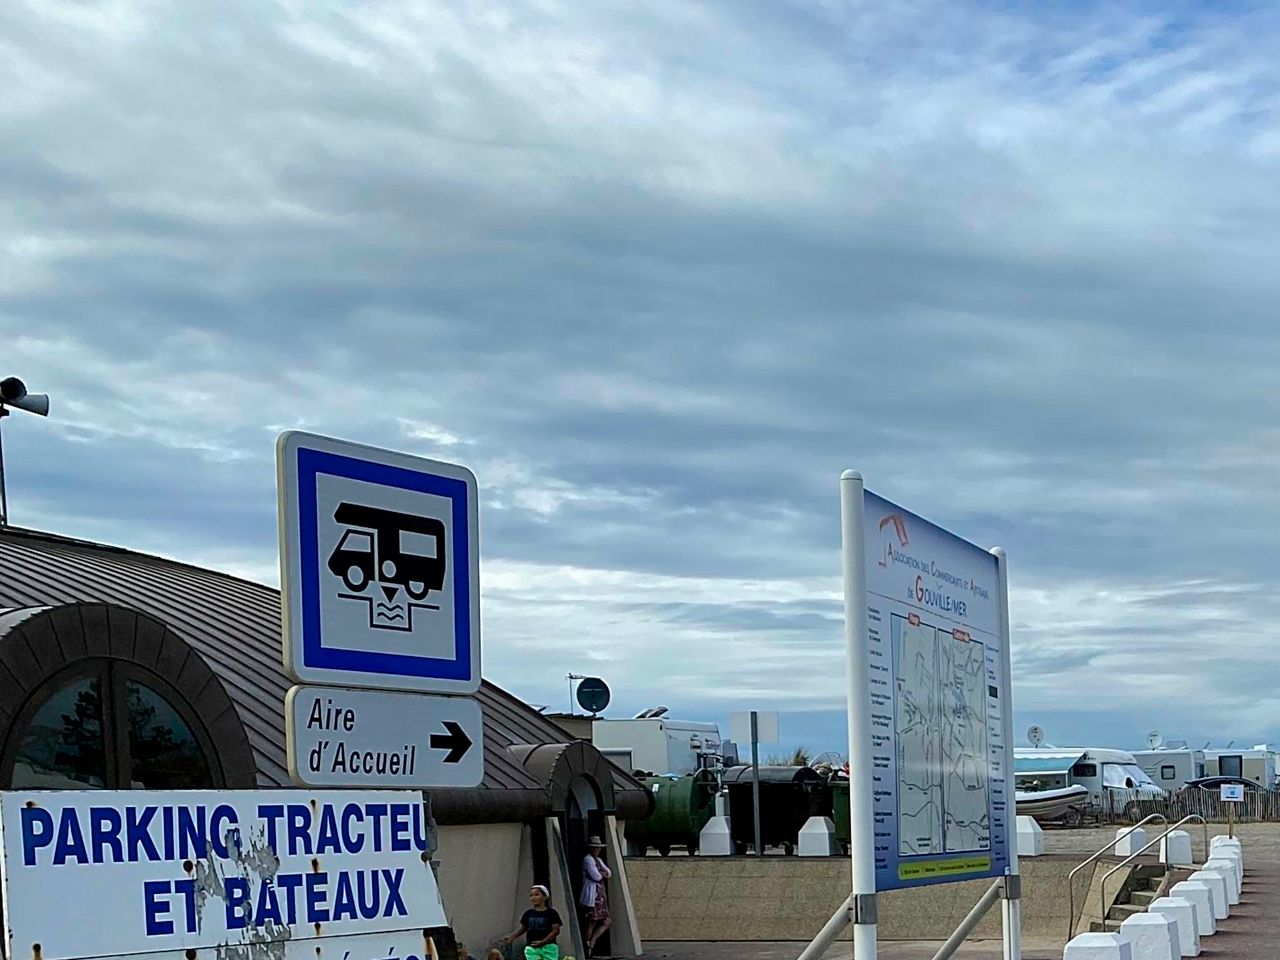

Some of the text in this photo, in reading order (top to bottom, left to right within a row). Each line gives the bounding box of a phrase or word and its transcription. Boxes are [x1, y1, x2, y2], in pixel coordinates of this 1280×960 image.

[307, 698, 355, 731] Aire
[309, 741, 416, 776] d'Accueil
[20, 804, 241, 866] PARKING
[143, 878, 199, 936] ET
